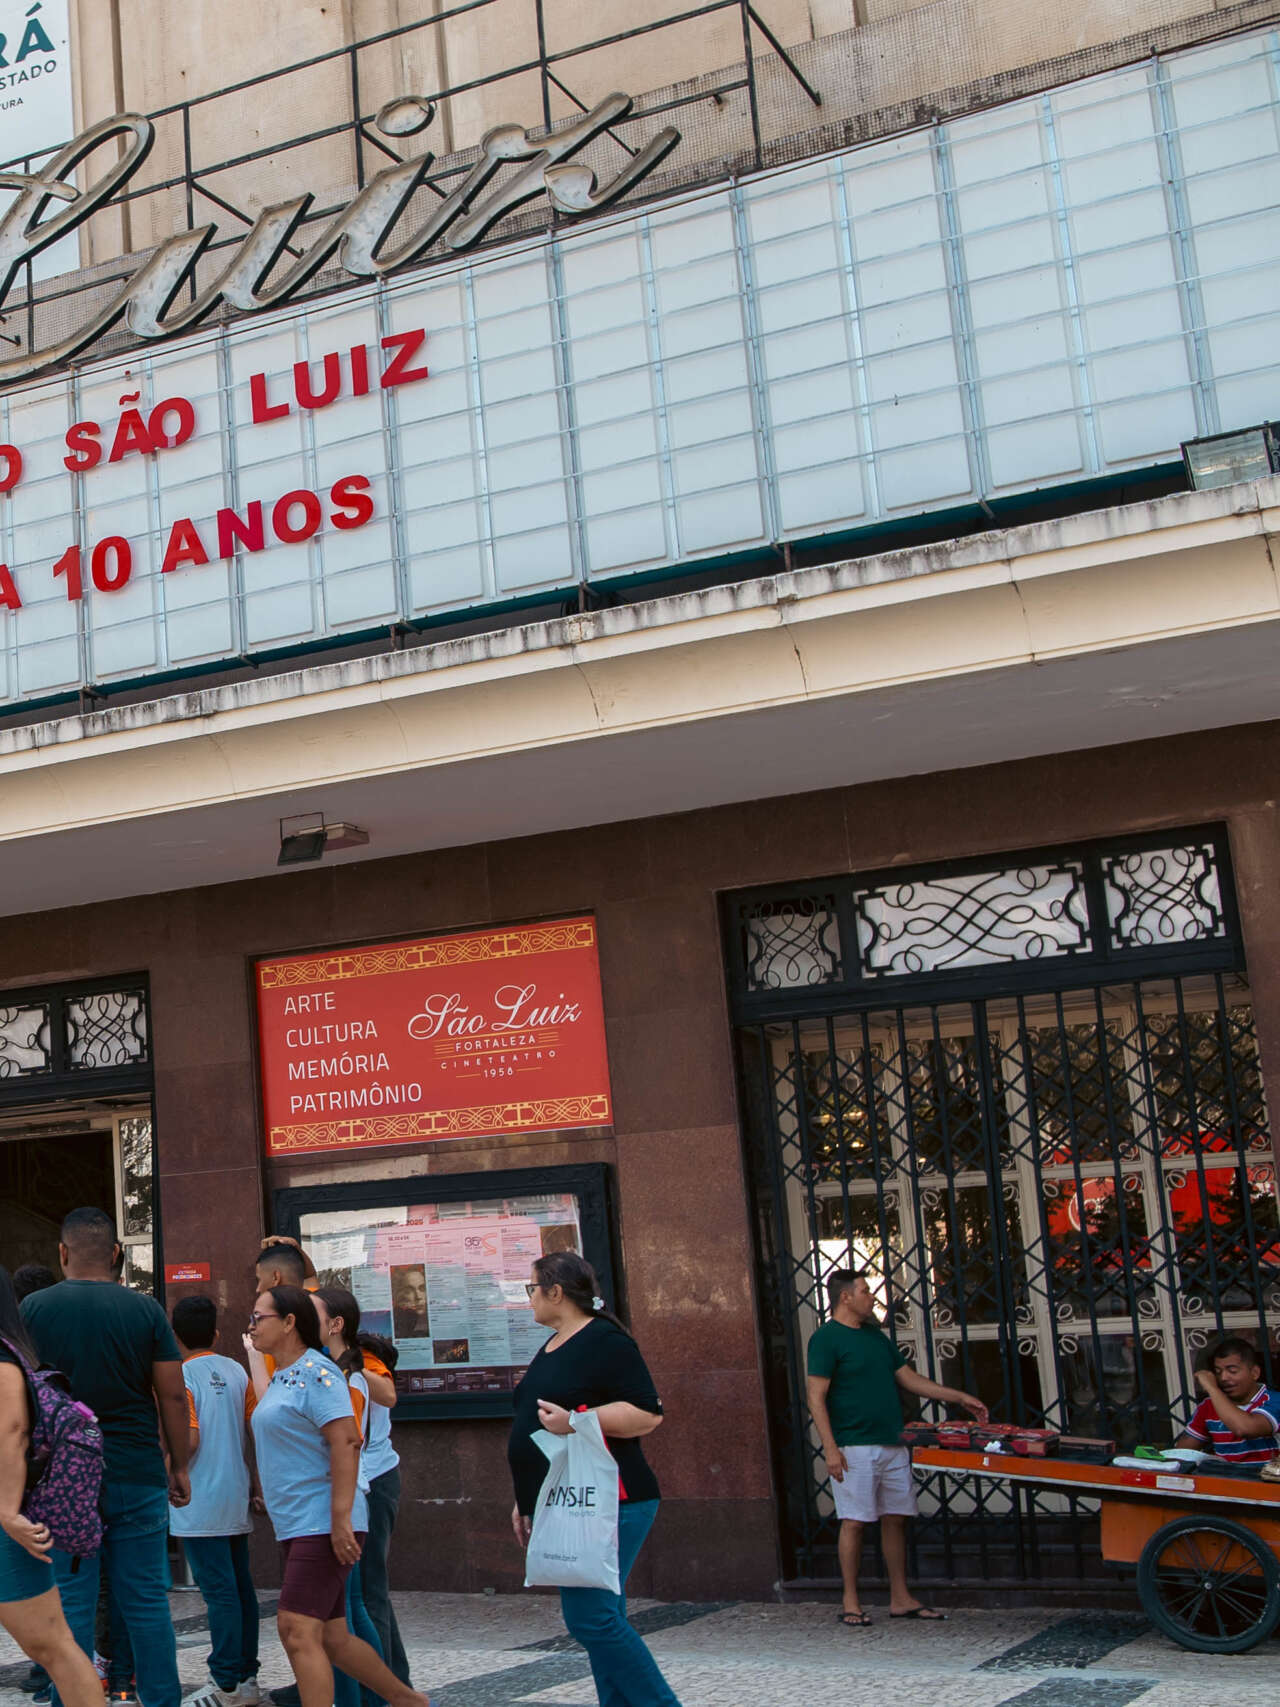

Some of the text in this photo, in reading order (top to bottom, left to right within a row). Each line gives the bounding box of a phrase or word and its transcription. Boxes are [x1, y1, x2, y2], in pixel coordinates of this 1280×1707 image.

[63, 390, 195, 473] SÃO
[249, 328, 429, 425] LUIZ
[52, 535, 132, 601] 10
[160, 474, 375, 574] ANOS
[283, 991, 336, 1016] ARTE
[407, 983, 583, 1040] São Luiz
[285, 1019, 379, 1048] CULTURA
[455, 1034, 536, 1052] FORTALEZA
[287, 1051, 390, 1081] MEMÓRIA
[290, 1082, 422, 1115] PATRIMÔNIO
